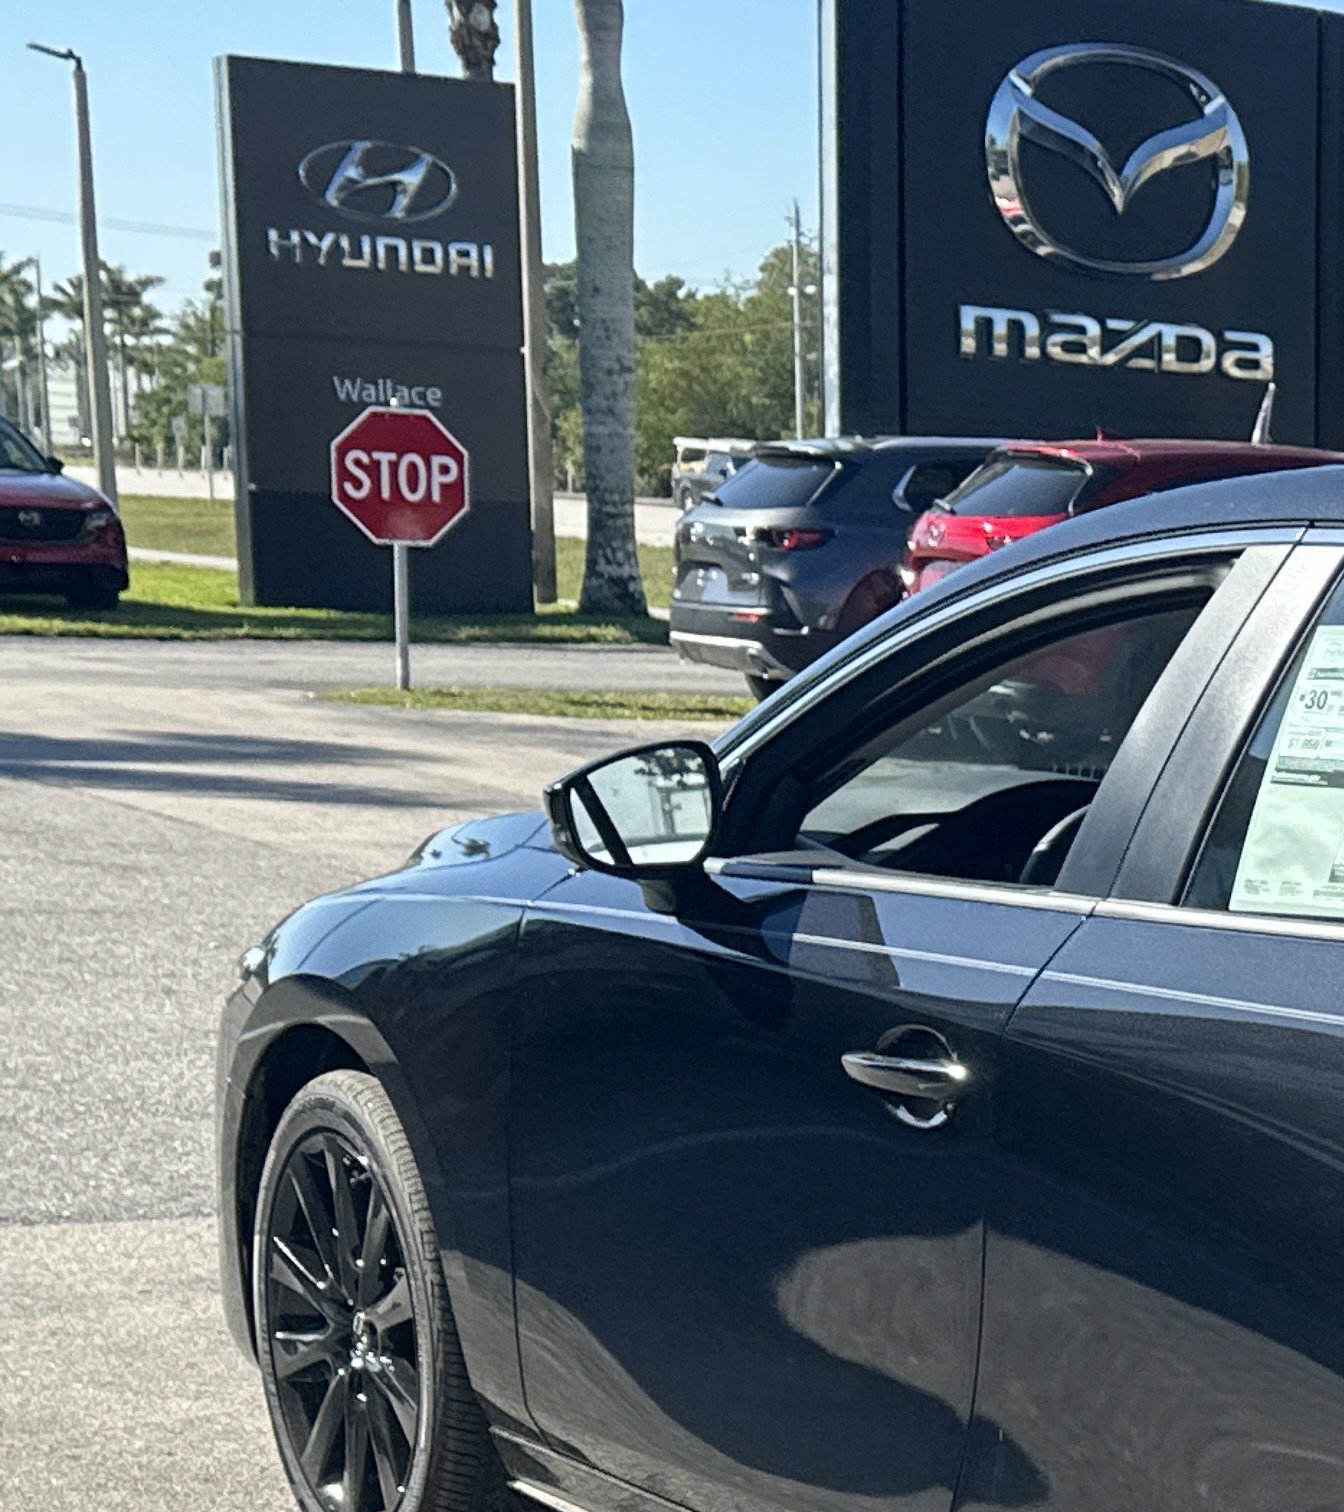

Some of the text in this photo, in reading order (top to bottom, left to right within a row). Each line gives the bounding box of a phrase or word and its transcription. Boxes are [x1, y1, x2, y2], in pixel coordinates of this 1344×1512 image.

[266, 227, 495, 279] HYUNDAI
[332, 376, 442, 407] Wallace
[343, 449, 459, 503] STOP
